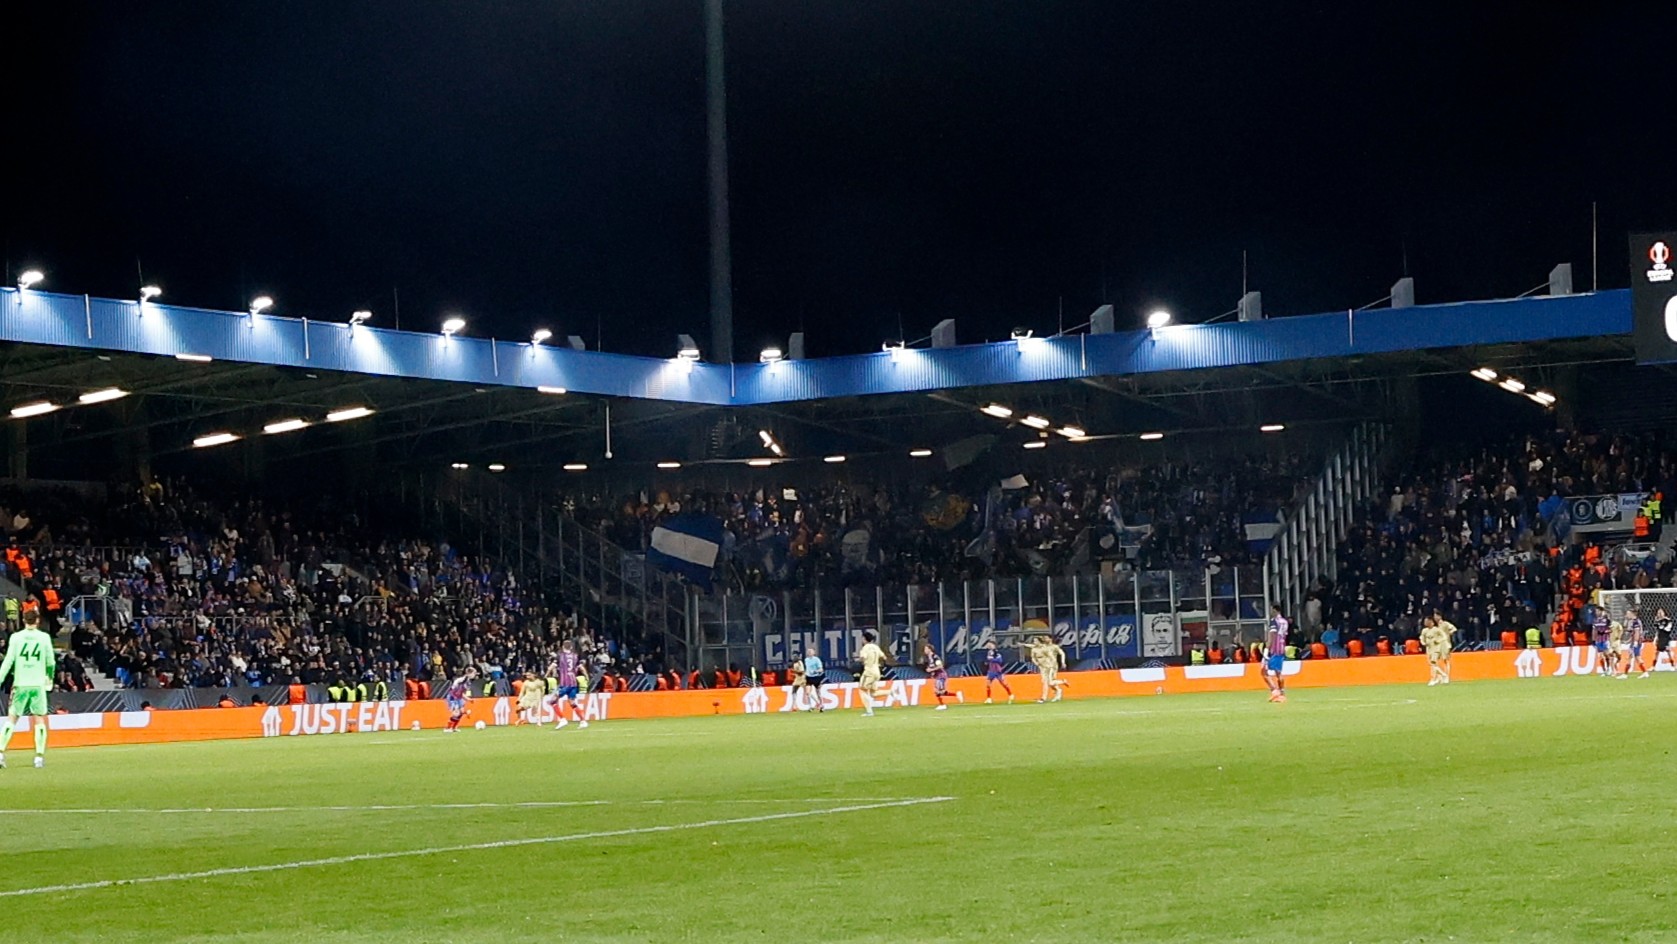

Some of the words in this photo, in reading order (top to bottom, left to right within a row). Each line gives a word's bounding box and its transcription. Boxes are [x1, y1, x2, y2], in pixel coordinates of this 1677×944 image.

[20, 643, 41, 661] 44
[567, 659, 574, 671] 3
[289, 702, 353, 736] JUST
[358, 700, 406, 732] EAT
